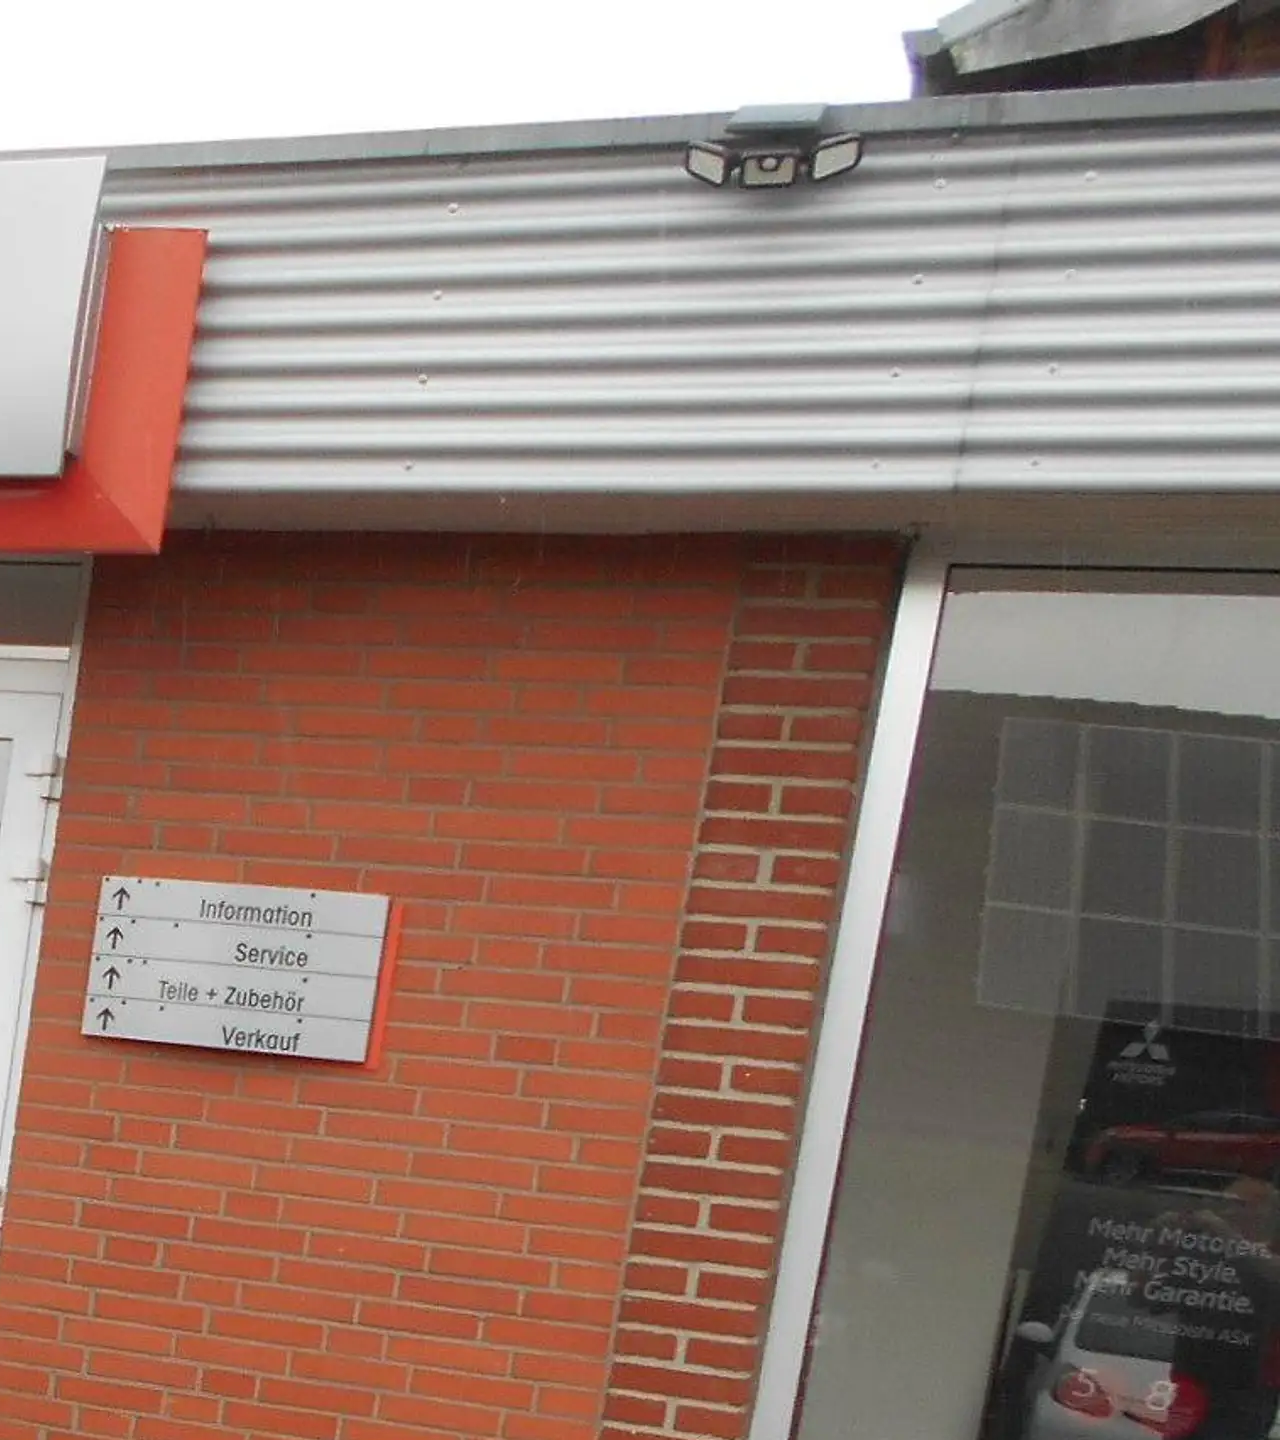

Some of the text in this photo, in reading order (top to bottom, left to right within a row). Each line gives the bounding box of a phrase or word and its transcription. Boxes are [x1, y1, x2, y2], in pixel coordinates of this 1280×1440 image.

[199, 899, 313, 928] Information
[234, 943, 309, 968] Service
[158, 979, 198, 1002] Teile
[224, 986, 305, 1013] Zubehör
[221, 1025, 301, 1052] Verkauf
[1087, 1216, 1154, 1243] Mehr
[1102, 1246, 1241, 1285] Mehr Style.
[1143, 1280, 1255, 1315] Garantie.
